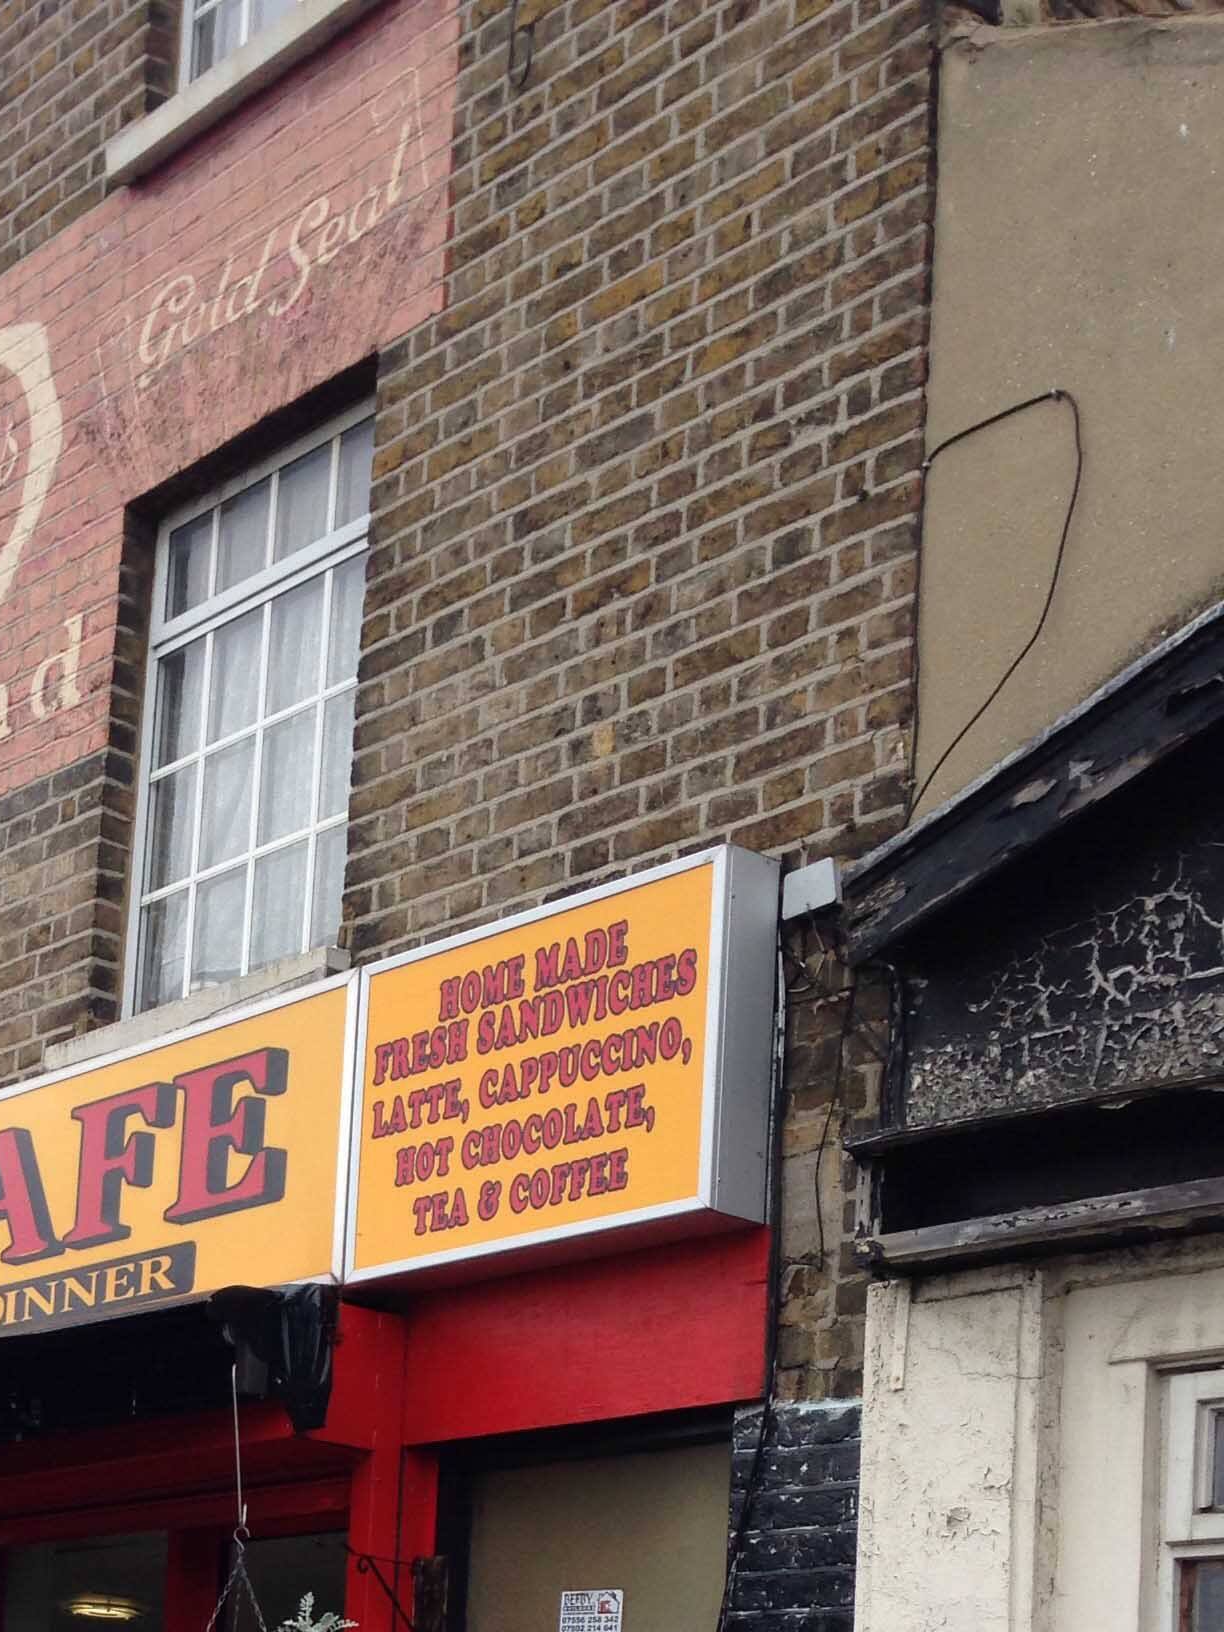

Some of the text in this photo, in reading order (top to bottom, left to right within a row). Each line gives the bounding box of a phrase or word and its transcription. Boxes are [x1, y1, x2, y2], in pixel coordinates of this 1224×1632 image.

[137, 119, 414, 372] Gold Seal
[372, 949, 698, 1086] FRESH SANDWICHES
[438, 920, 629, 1021] HOME MADE
[371, 1016, 693, 1139] LATTE, CAPPUCCINO,
[394, 1083, 656, 1187] HOT CHOCOLATE,
[413, 1147, 629, 1236] TEA & COFFEE
